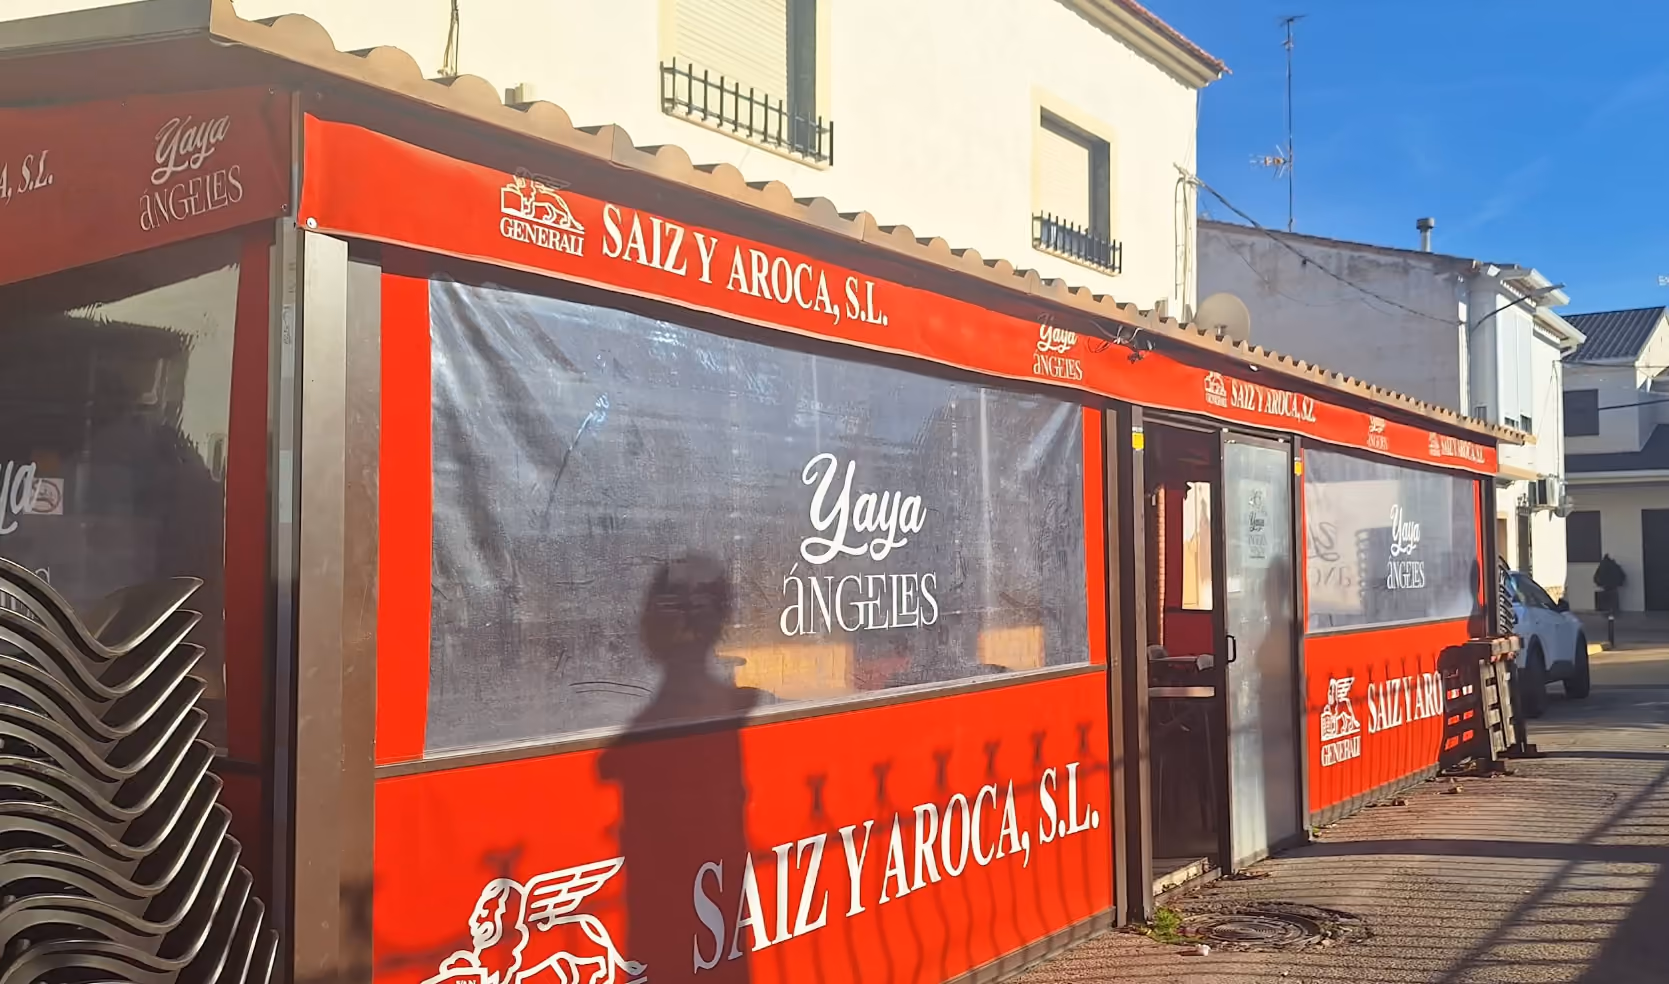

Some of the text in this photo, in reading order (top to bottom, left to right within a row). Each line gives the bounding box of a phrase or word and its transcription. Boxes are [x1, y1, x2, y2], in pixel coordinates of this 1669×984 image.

[17, 149, 53, 194] S.L.
[151, 115, 230, 185] Yaya
[500, 216, 585, 257] GENERALI
[601, 203, 888, 327] SAIZ Y AROCA, S.L.
[1037, 312, 1078, 354] Yaya
[1231, 379, 1255, 411] SAIZ
[1255, 386, 1266, 413] Y
[801, 453, 927, 564] Yaya
[1390, 504, 1421, 557] Yaya
[1368, 678, 1402, 734] SAIZ
[1402, 675, 1414, 723] Y
[693, 761, 1100, 974] SAIZ Y AROCA, S.L.
